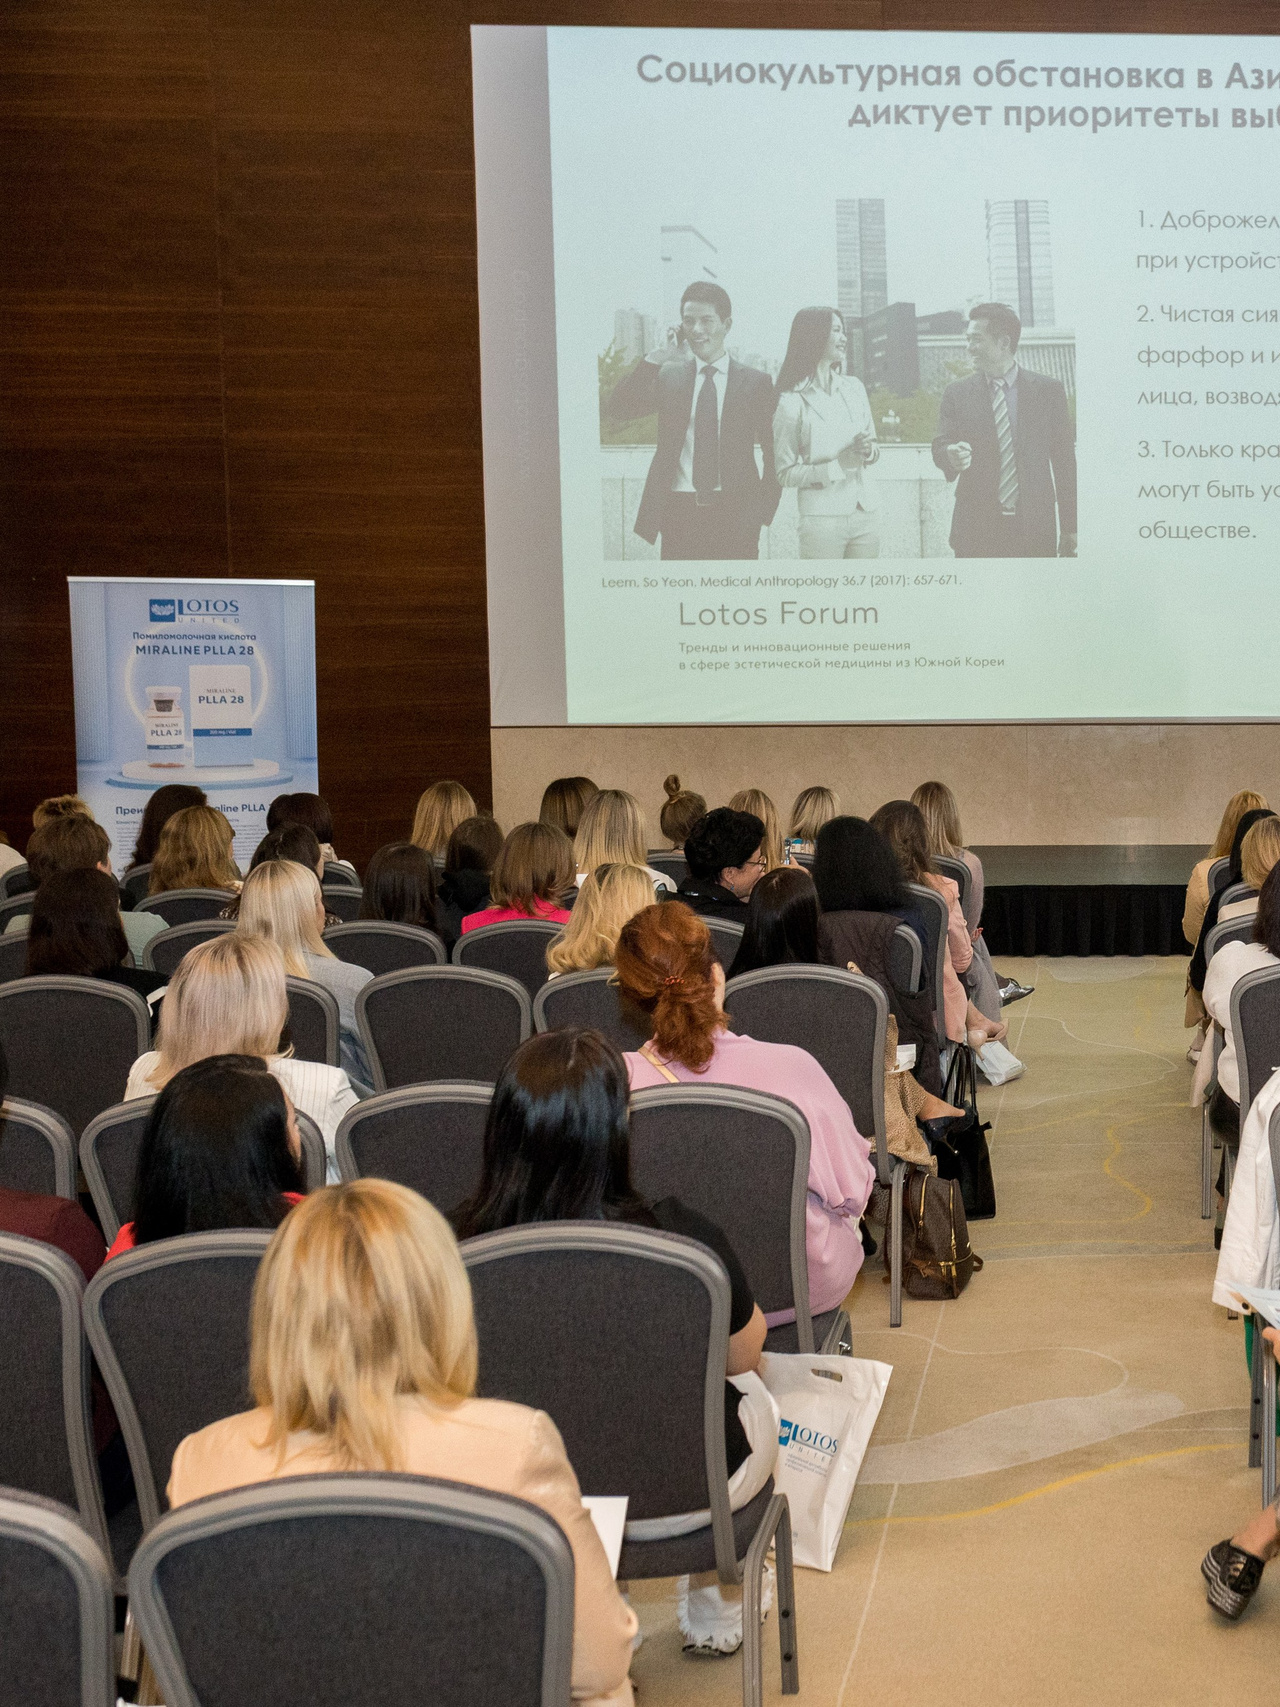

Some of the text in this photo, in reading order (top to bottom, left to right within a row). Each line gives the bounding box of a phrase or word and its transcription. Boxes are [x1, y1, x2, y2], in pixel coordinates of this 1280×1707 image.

[637, 54, 960, 93] Социокультурная
[973, 58, 1184, 89] обстановка
[1197, 68, 1213, 89] в
[848, 104, 992, 132] диктует
[1004, 105, 1218, 134] приоритеты
[1137, 210, 1154, 228] 1.
[1137, 255, 1177, 272] при
[1137, 305, 1154, 322] 2.
[1161, 305, 1234, 322] Чистая
[1137, 345, 1244, 367] фарфор
[1251, 350, 1264, 363] и
[1138, 391, 1197, 406] лица,
[1138, 440, 1155, 458] 3.
[1162, 440, 1234, 458] Только
[1138, 485, 1200, 502] могут
[1207, 480, 1255, 498] быть
[1139, 520, 1256, 540] обществе.
[643, 577, 658, 588] So
[661, 576, 697, 588] Yeon.
[700, 576, 751, 587] Medical
[755, 576, 839, 589] Anthropology
[843, 575, 866, 586] 36.7
[870, 574, 910, 587] (2017):
[913, 574, 962, 586] 657-671.
[178, 599, 240, 615] LOTOS
[680, 600, 878, 626] Lotos Forum
[136, 645, 254, 655] MIRALINE PLLA 28
[679, 642, 727, 654] Тренды
[744, 643, 849, 653] инновационные
[853, 643, 910, 653] решения
[679, 657, 1004, 671] в сфере эстетической медицины из Южной Кореи
[198, 696, 227, 704] PLLA
[241, 803, 266, 812] PLLA
[792, 1424, 838, 1454] LOTOS
